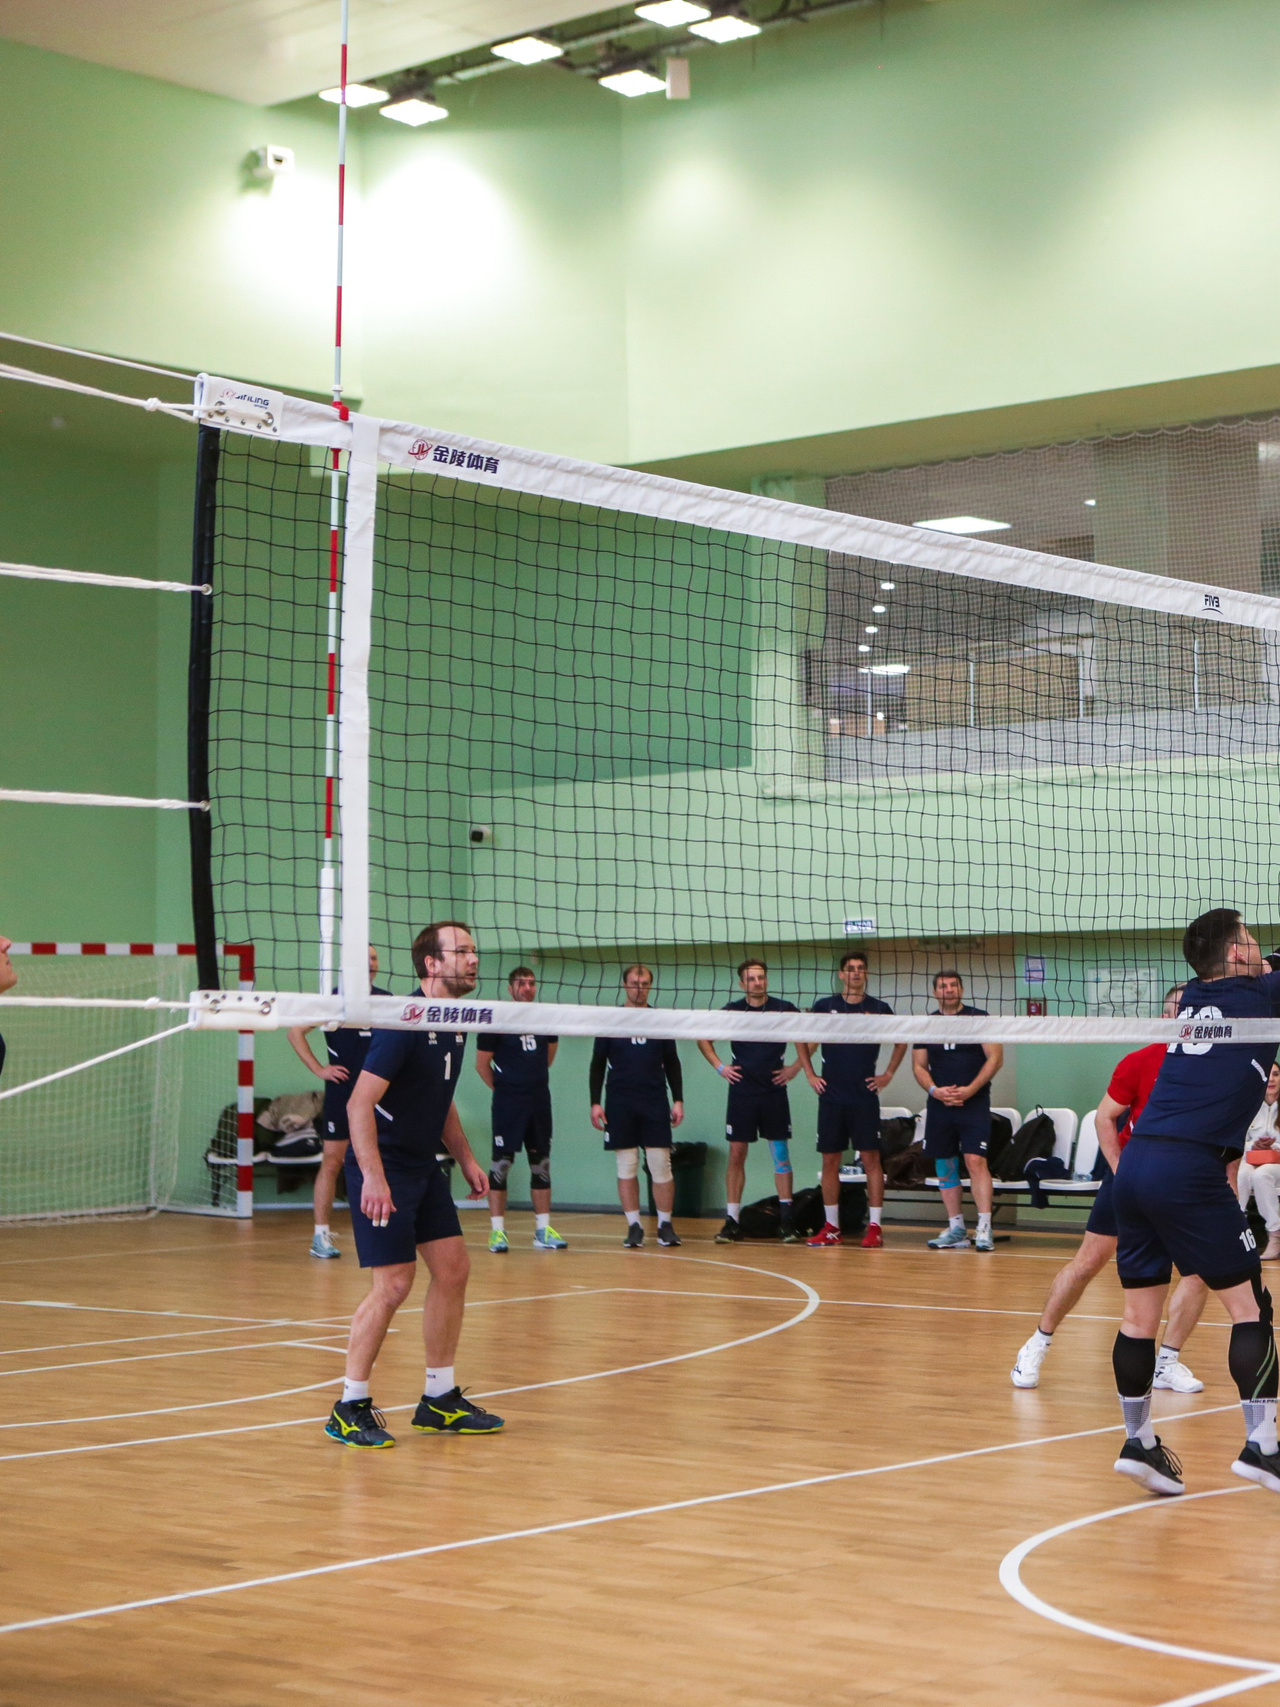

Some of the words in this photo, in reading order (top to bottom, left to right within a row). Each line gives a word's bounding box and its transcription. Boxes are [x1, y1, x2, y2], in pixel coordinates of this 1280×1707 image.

[432, 445, 500, 474] 金陵体育
[426, 1006, 493, 1025] 金陵体育
[519, 1034, 537, 1052] 15
[444, 1052, 452, 1080] 1
[1239, 1228, 1257, 1252] 16
